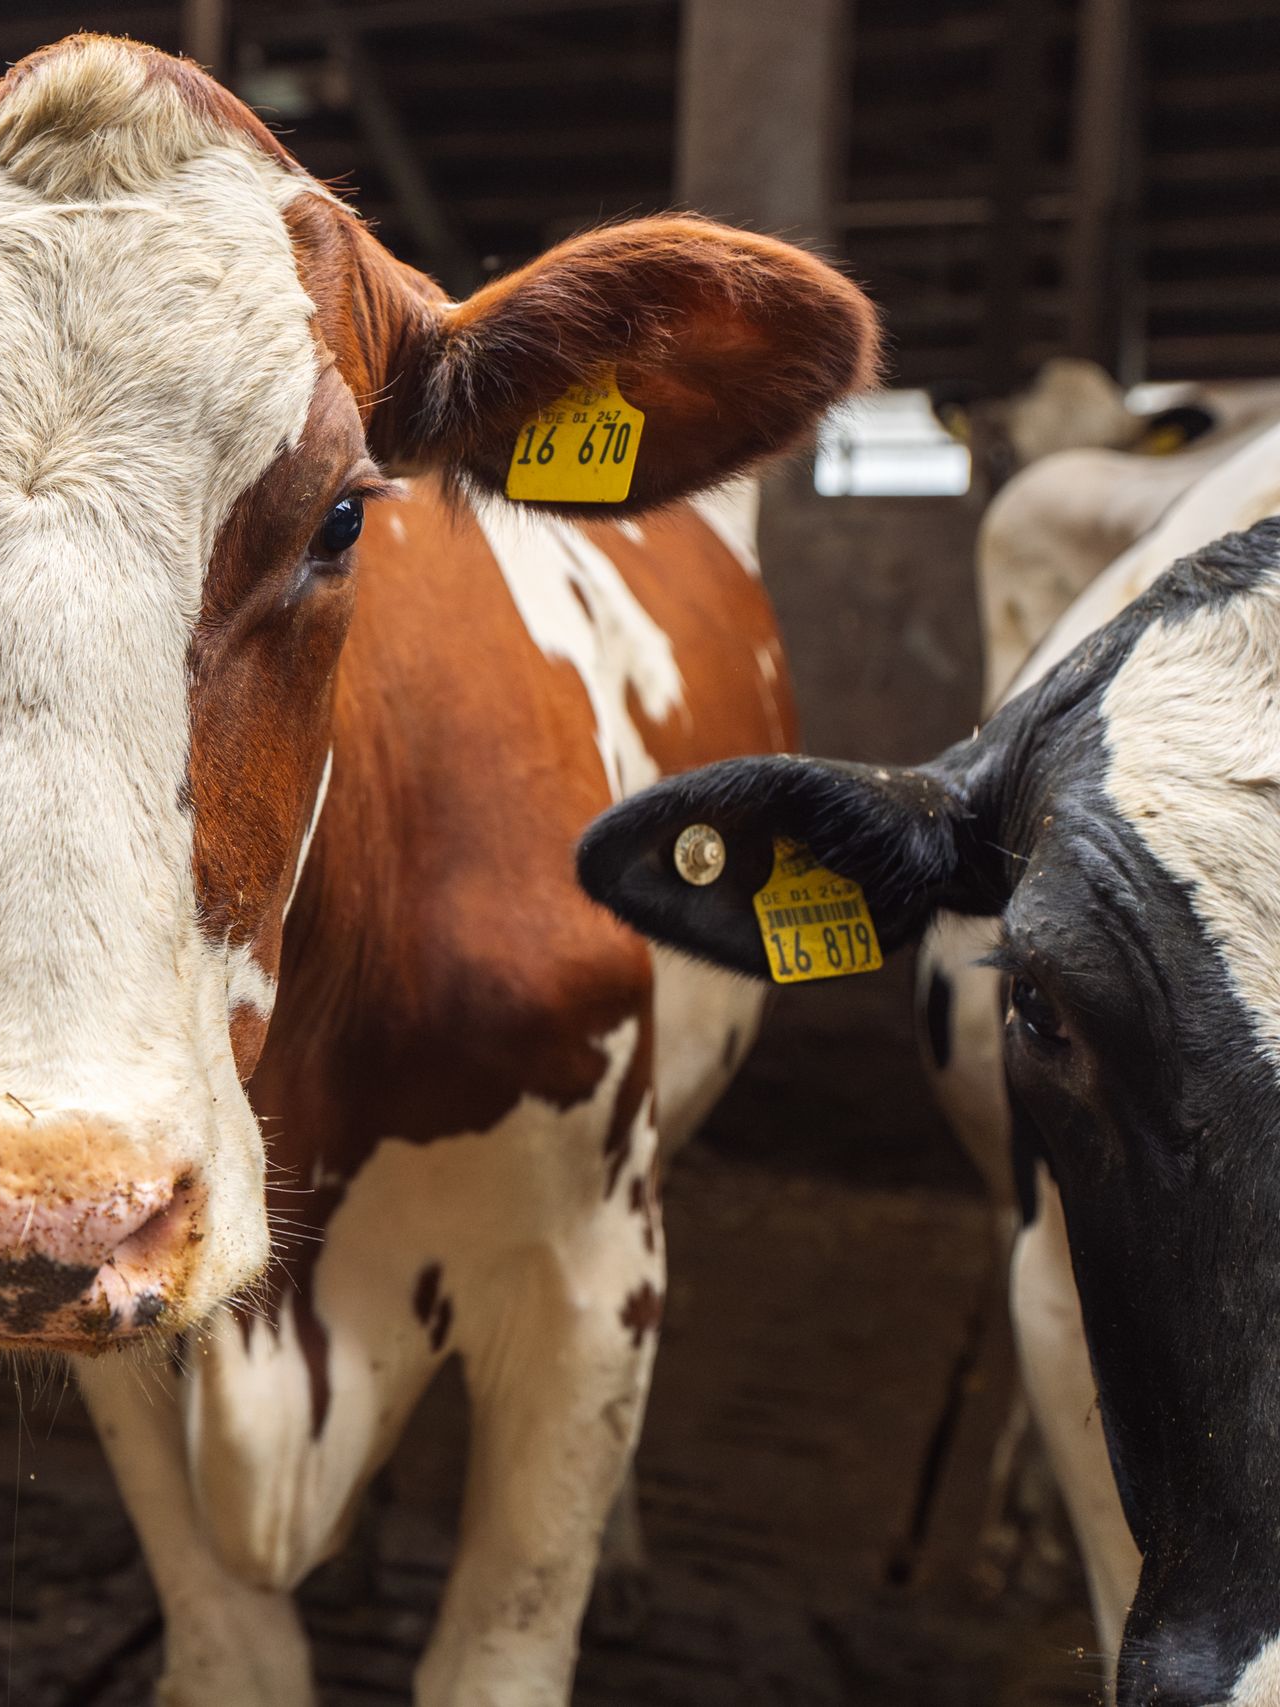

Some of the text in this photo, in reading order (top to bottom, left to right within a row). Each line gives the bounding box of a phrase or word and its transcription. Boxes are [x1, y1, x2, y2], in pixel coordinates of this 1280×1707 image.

[572, 412, 588, 424] 01
[596, 410, 621, 422] 247
[517, 422, 631, 465] 16 670
[771, 922, 872, 976] 16 879
